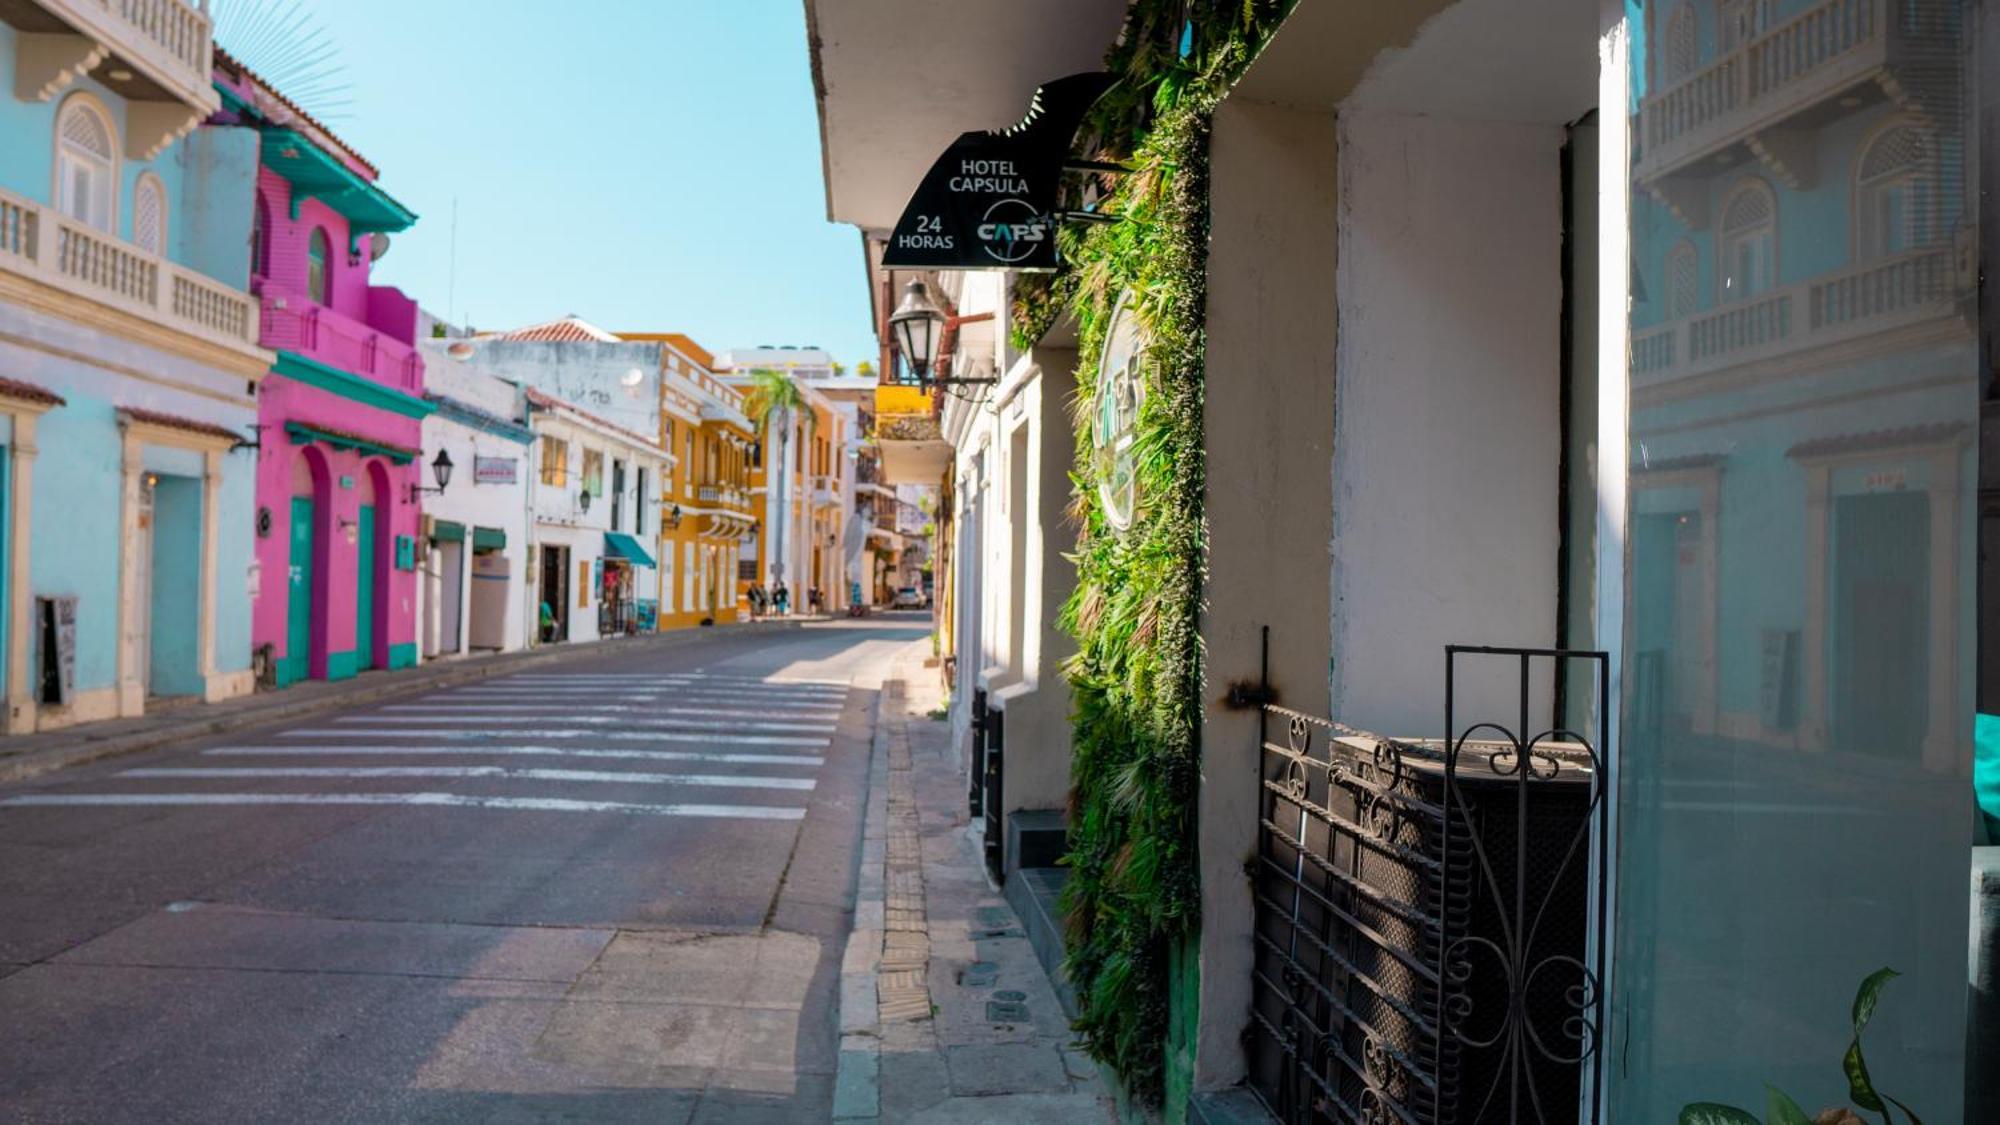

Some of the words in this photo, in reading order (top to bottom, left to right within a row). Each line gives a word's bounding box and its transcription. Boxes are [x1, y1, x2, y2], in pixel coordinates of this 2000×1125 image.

[961, 159, 1018, 176] HOTEL
[950, 176, 1029, 194] CAPSULA
[916, 215, 942, 233] 24
[899, 235, 954, 250] HORAS
